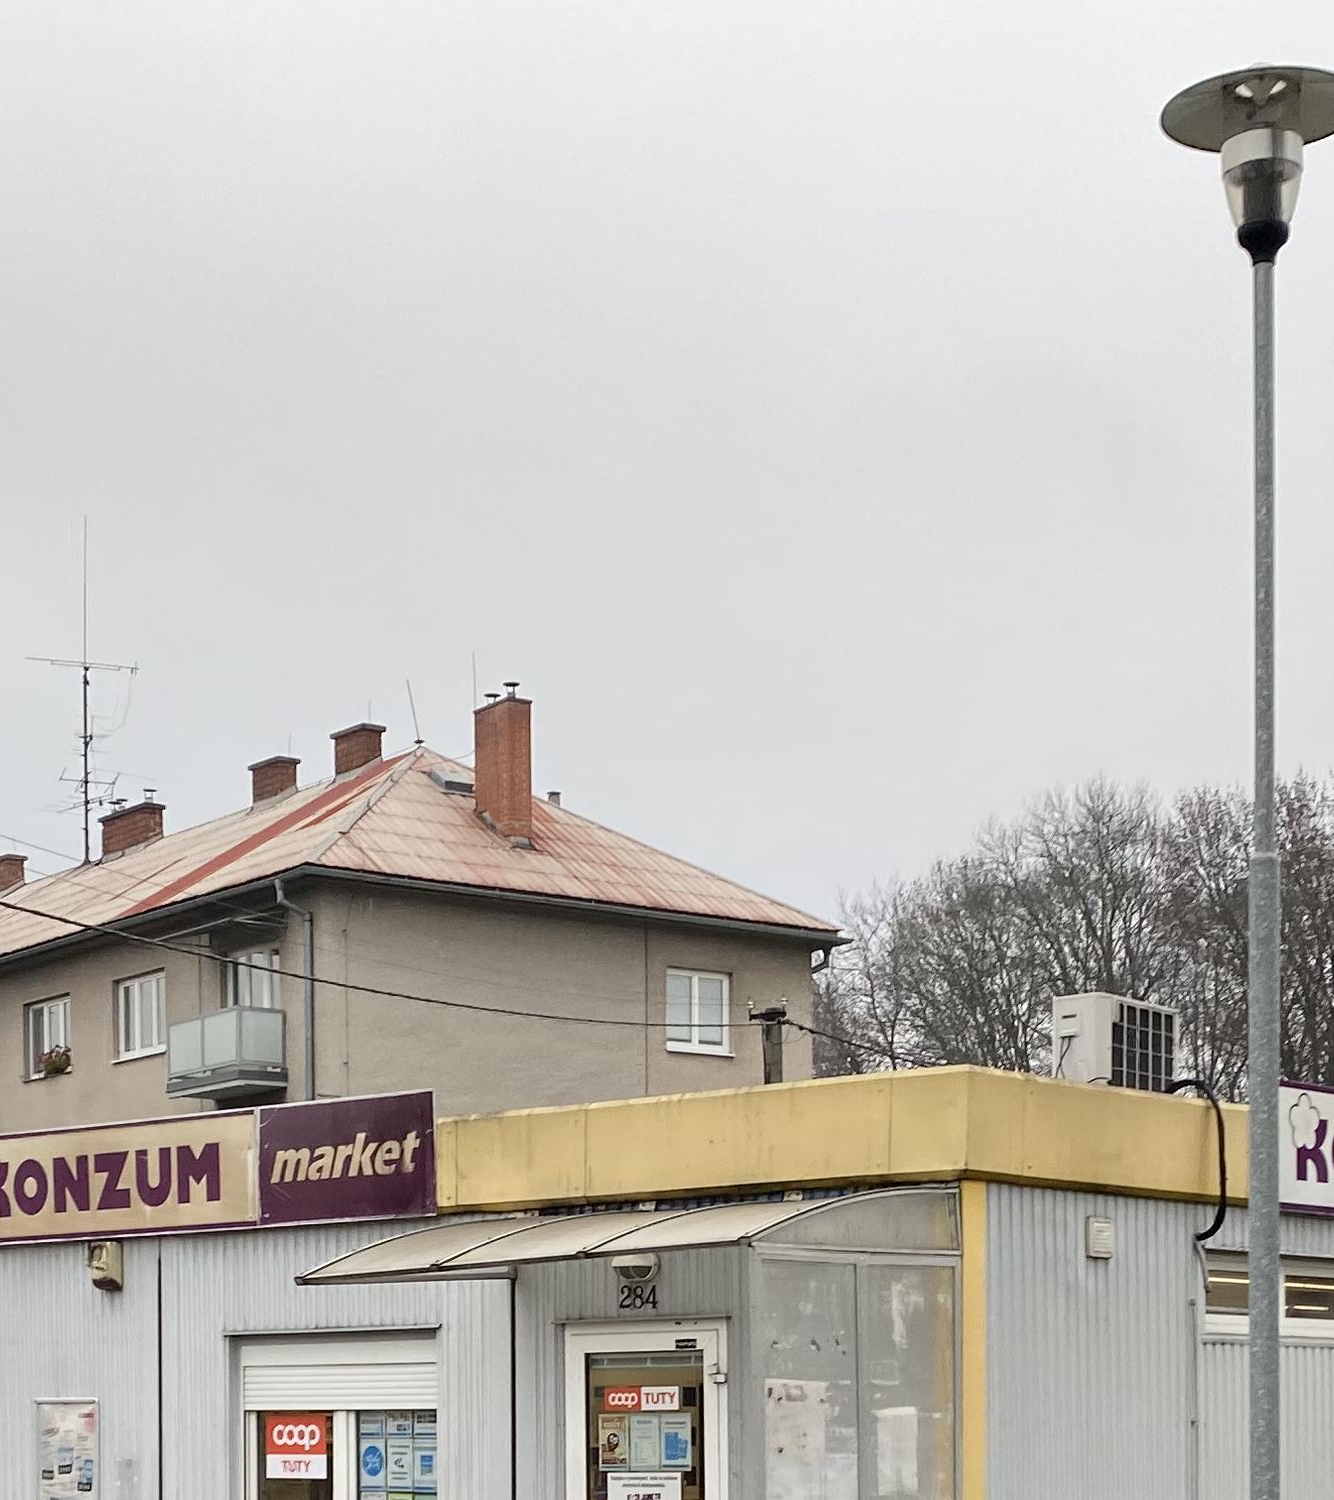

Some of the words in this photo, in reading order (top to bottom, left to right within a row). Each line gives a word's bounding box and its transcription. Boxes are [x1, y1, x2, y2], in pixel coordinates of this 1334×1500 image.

[270, 1131, 420, 1185] market
[619, 1285, 658, 1309] 284
[608, 1392, 638, 1408] coop
[643, 1391, 676, 1405] TUTY
[272, 1424, 321, 1450] coop
[281, 1460, 311, 1472] TUTY
